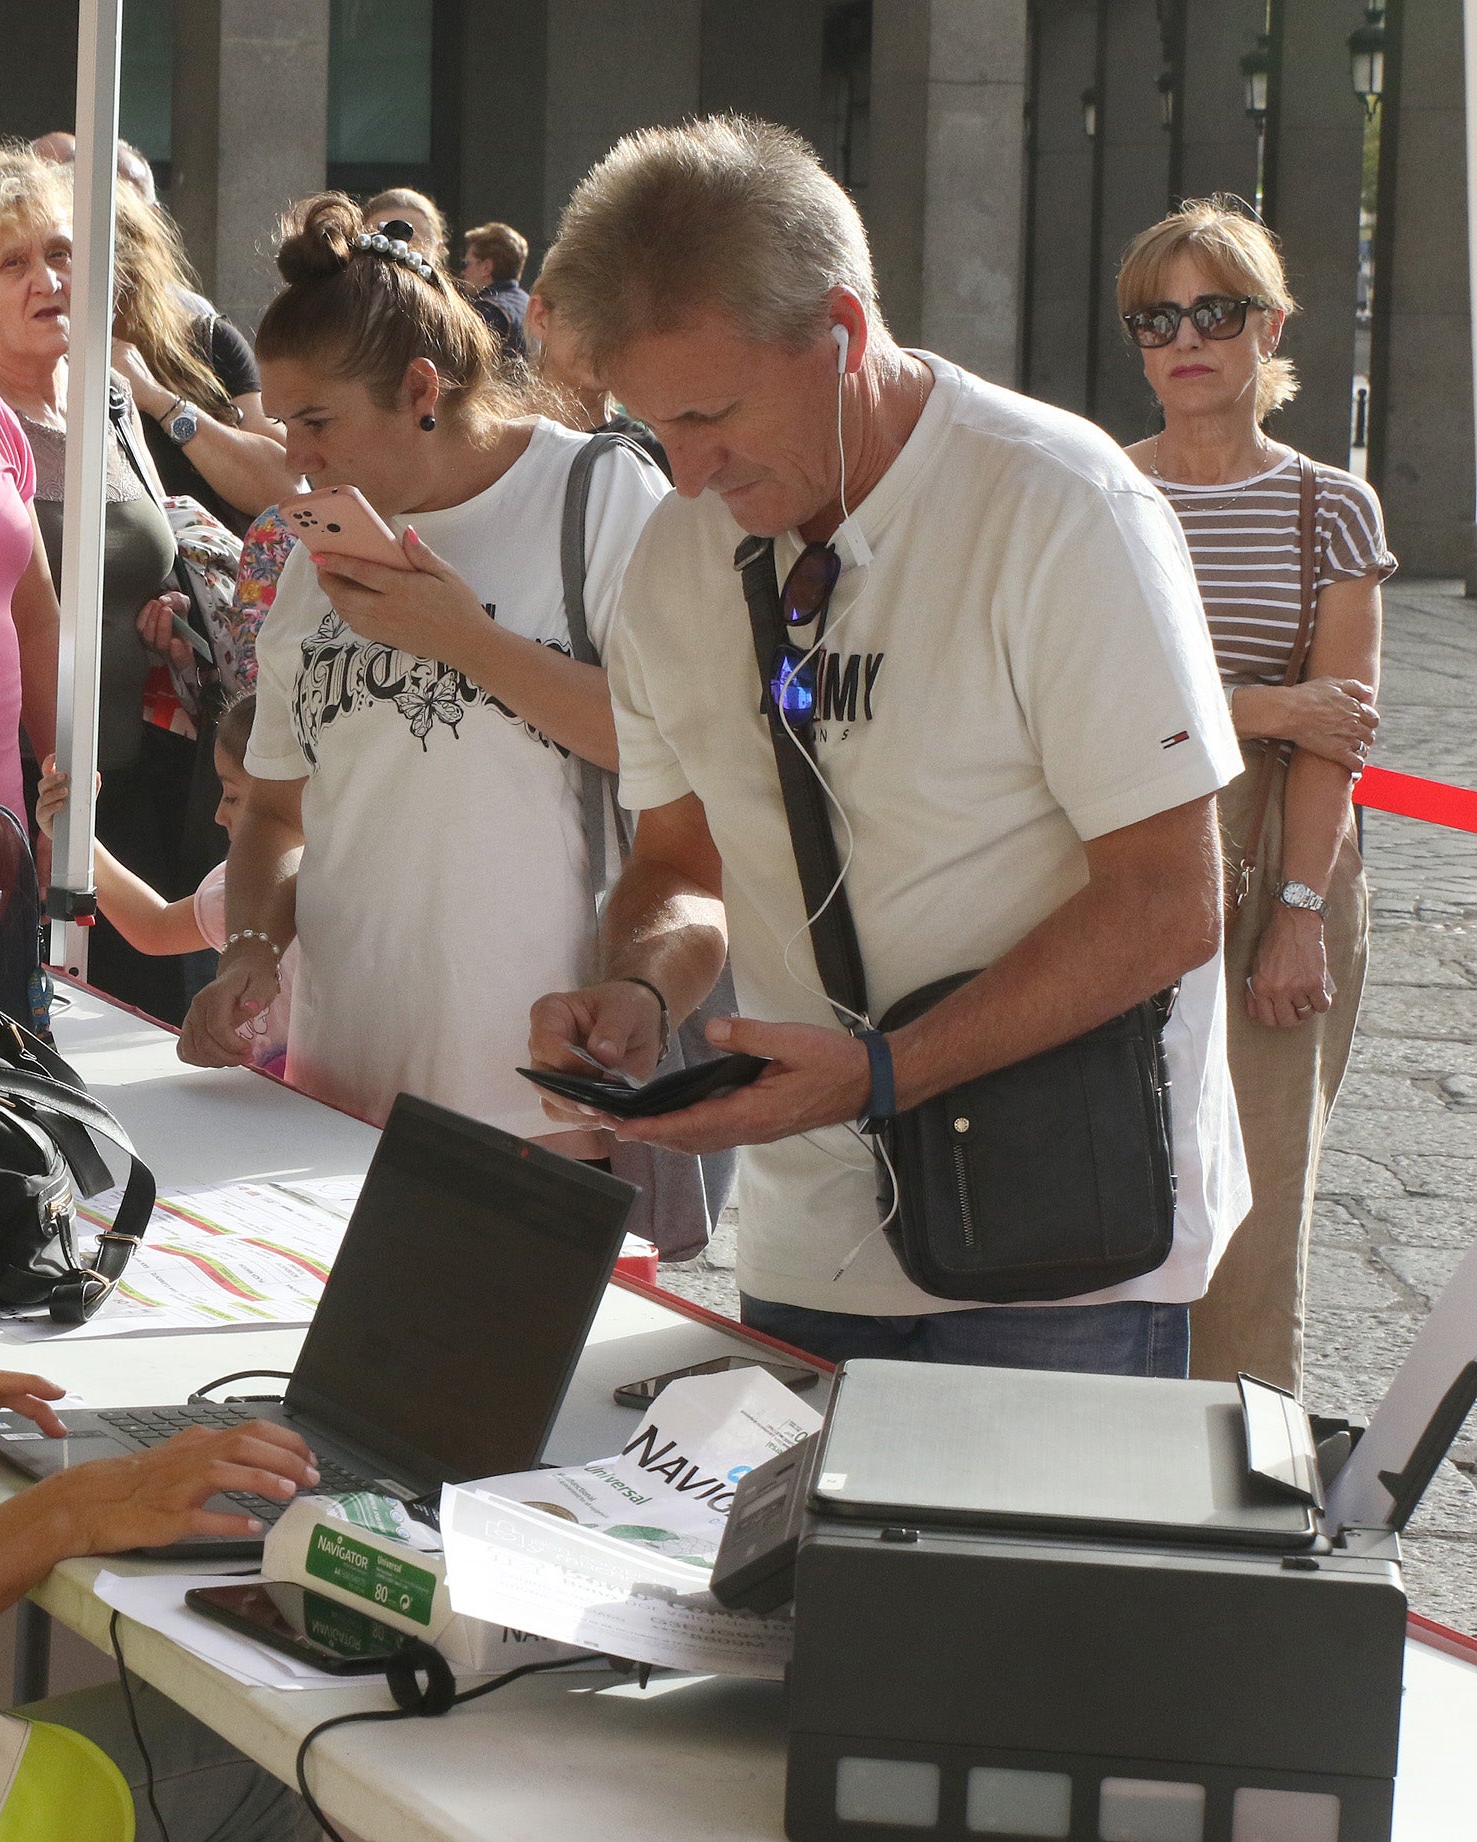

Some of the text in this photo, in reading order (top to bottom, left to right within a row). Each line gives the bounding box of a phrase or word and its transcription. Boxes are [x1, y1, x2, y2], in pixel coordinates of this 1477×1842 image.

[583, 1464, 652, 1506] Universal
[621, 1424, 734, 1517] NAVIG
[317, 1535, 369, 1570] NAVIGATOR
[376, 1555, 403, 1574] Universal
[374, 1583, 389, 1603] 80
